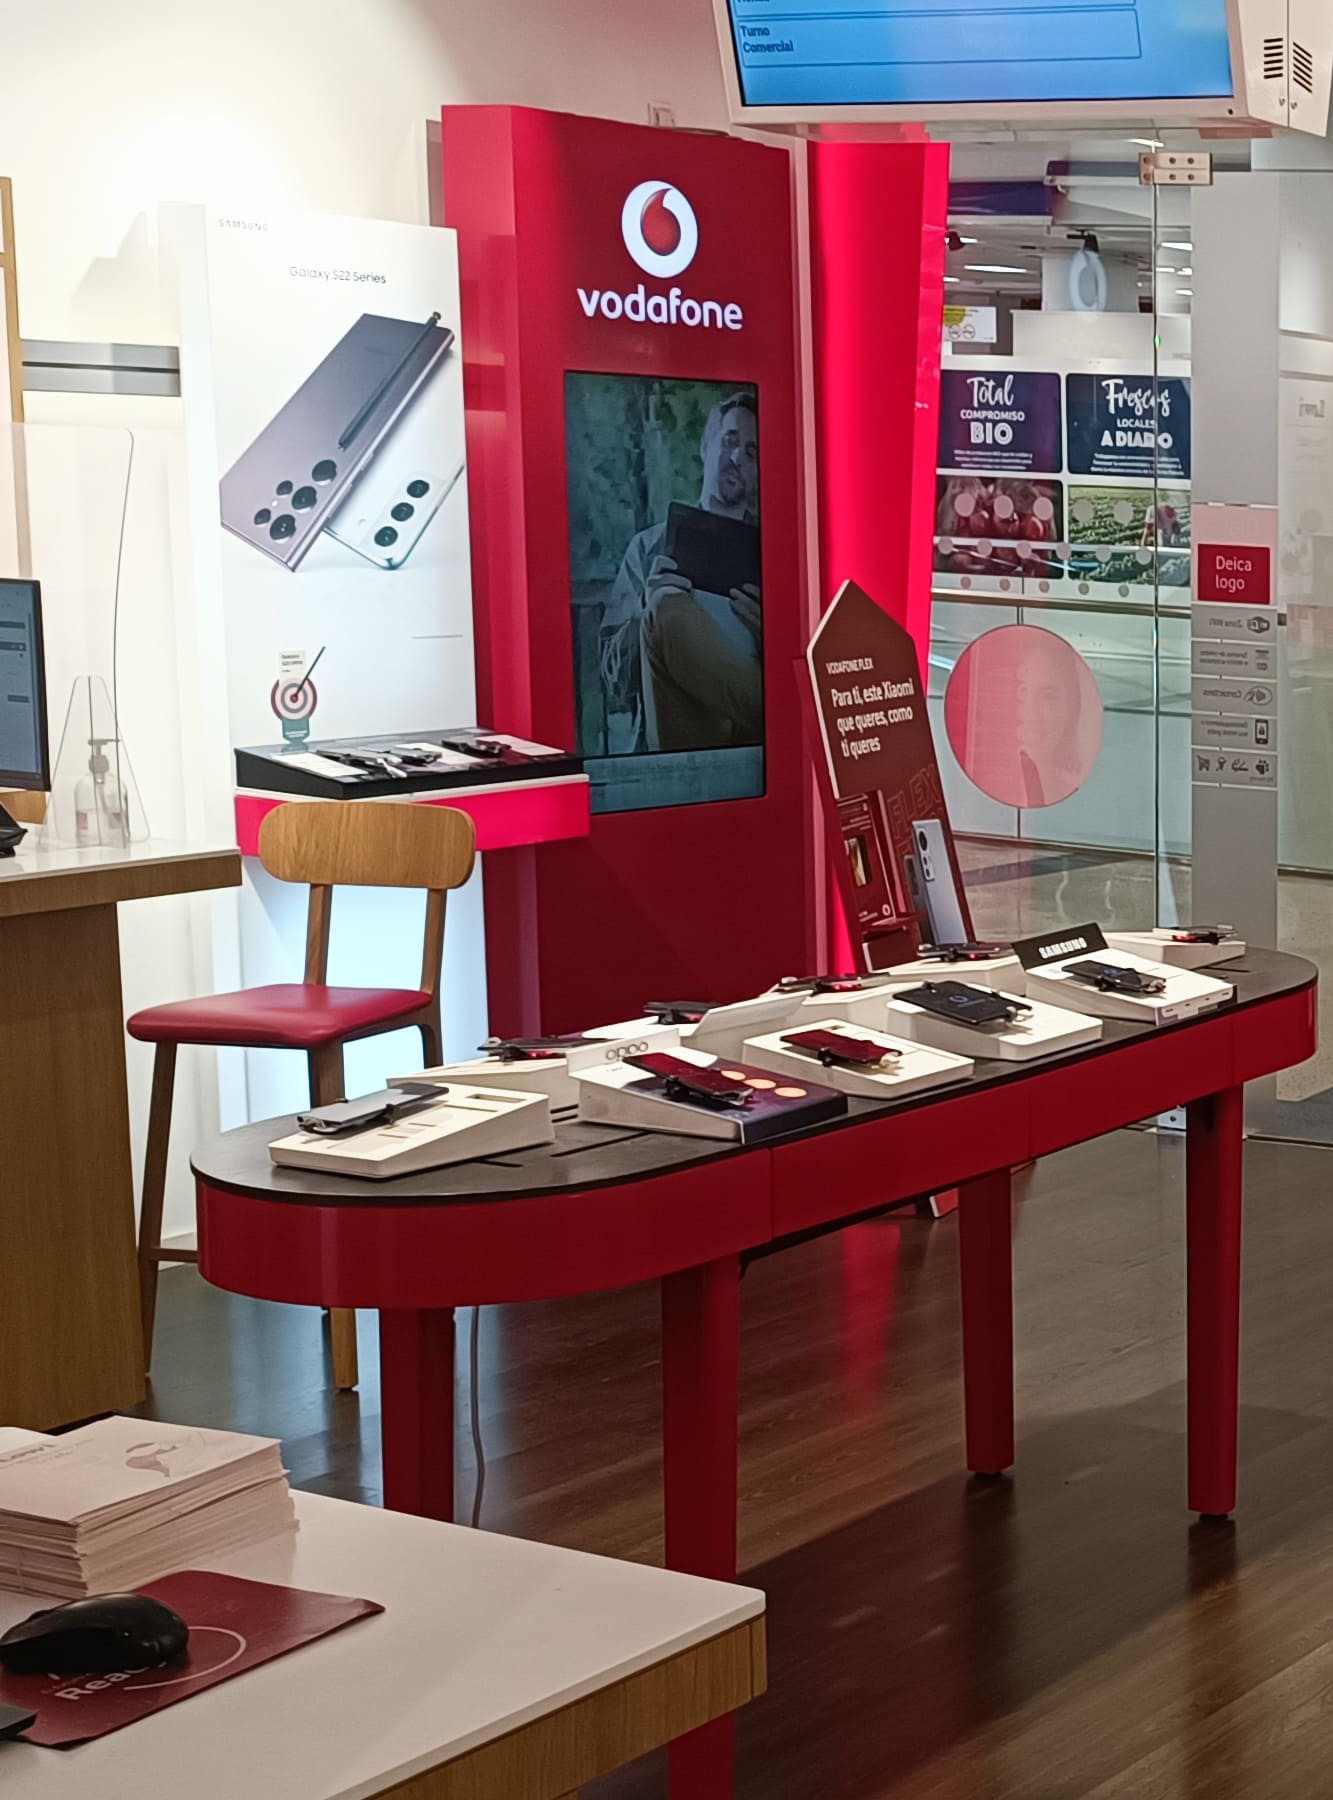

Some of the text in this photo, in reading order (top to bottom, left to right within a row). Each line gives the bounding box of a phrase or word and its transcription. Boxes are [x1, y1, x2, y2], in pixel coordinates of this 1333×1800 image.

[740, 26, 770, 37] Turno
[743, 40, 794, 53] Comercial
[218, 218, 270, 232] SAMSUNG
[289, 266, 387, 284] Galaxy S22 Series
[576, 283, 744, 330] vodafone
[966, 374, 1015, 408] Total
[960, 408, 1026, 421] COMPROMISO
[970, 422, 1014, 445] BIO
[1101, 430, 1114, 447] A
[1215, 555, 1252, 573] Deica
[1215, 574, 1246, 594] logo
[825, 659, 861, 675] VODAFONE
[831, 677, 915, 708] Para ti, este Xiaomi
[836, 706, 914, 737] que queres, como
[841, 737, 881, 760] ti queres
[1038, 936, 1088, 959] SAMSUNG
[605, 1041, 649, 1062] oppo
